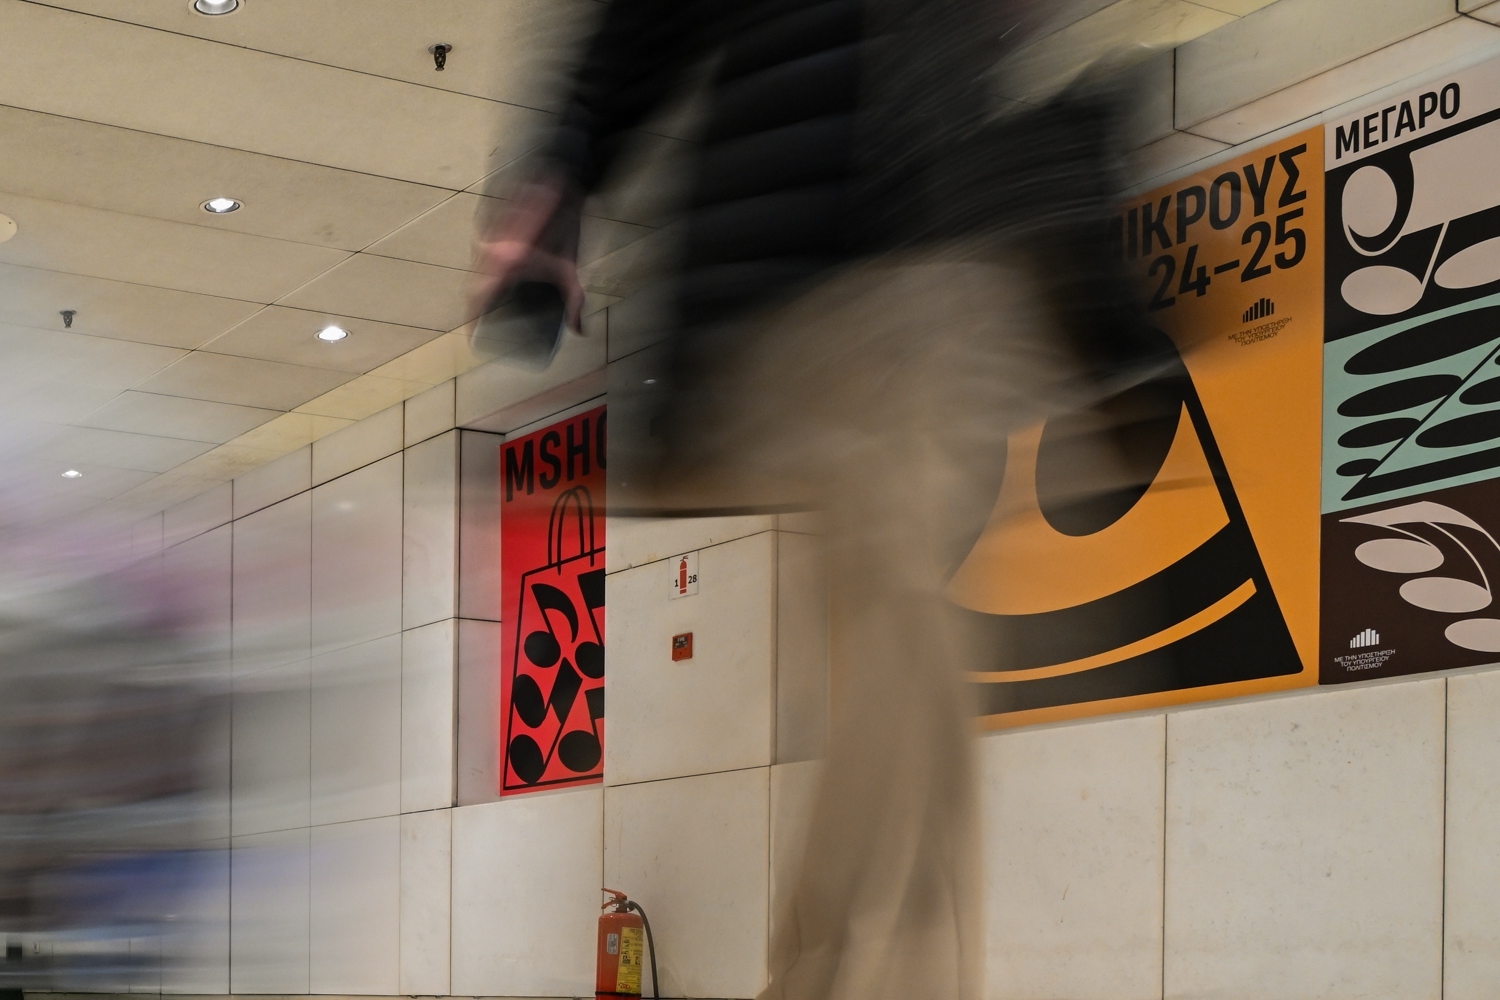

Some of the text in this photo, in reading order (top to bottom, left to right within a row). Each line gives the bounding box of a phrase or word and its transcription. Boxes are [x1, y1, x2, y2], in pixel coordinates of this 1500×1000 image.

[1335, 82, 1461, 160] ΜΕΓΑΡΟ
[674, 574, 698, 587] 1 28
